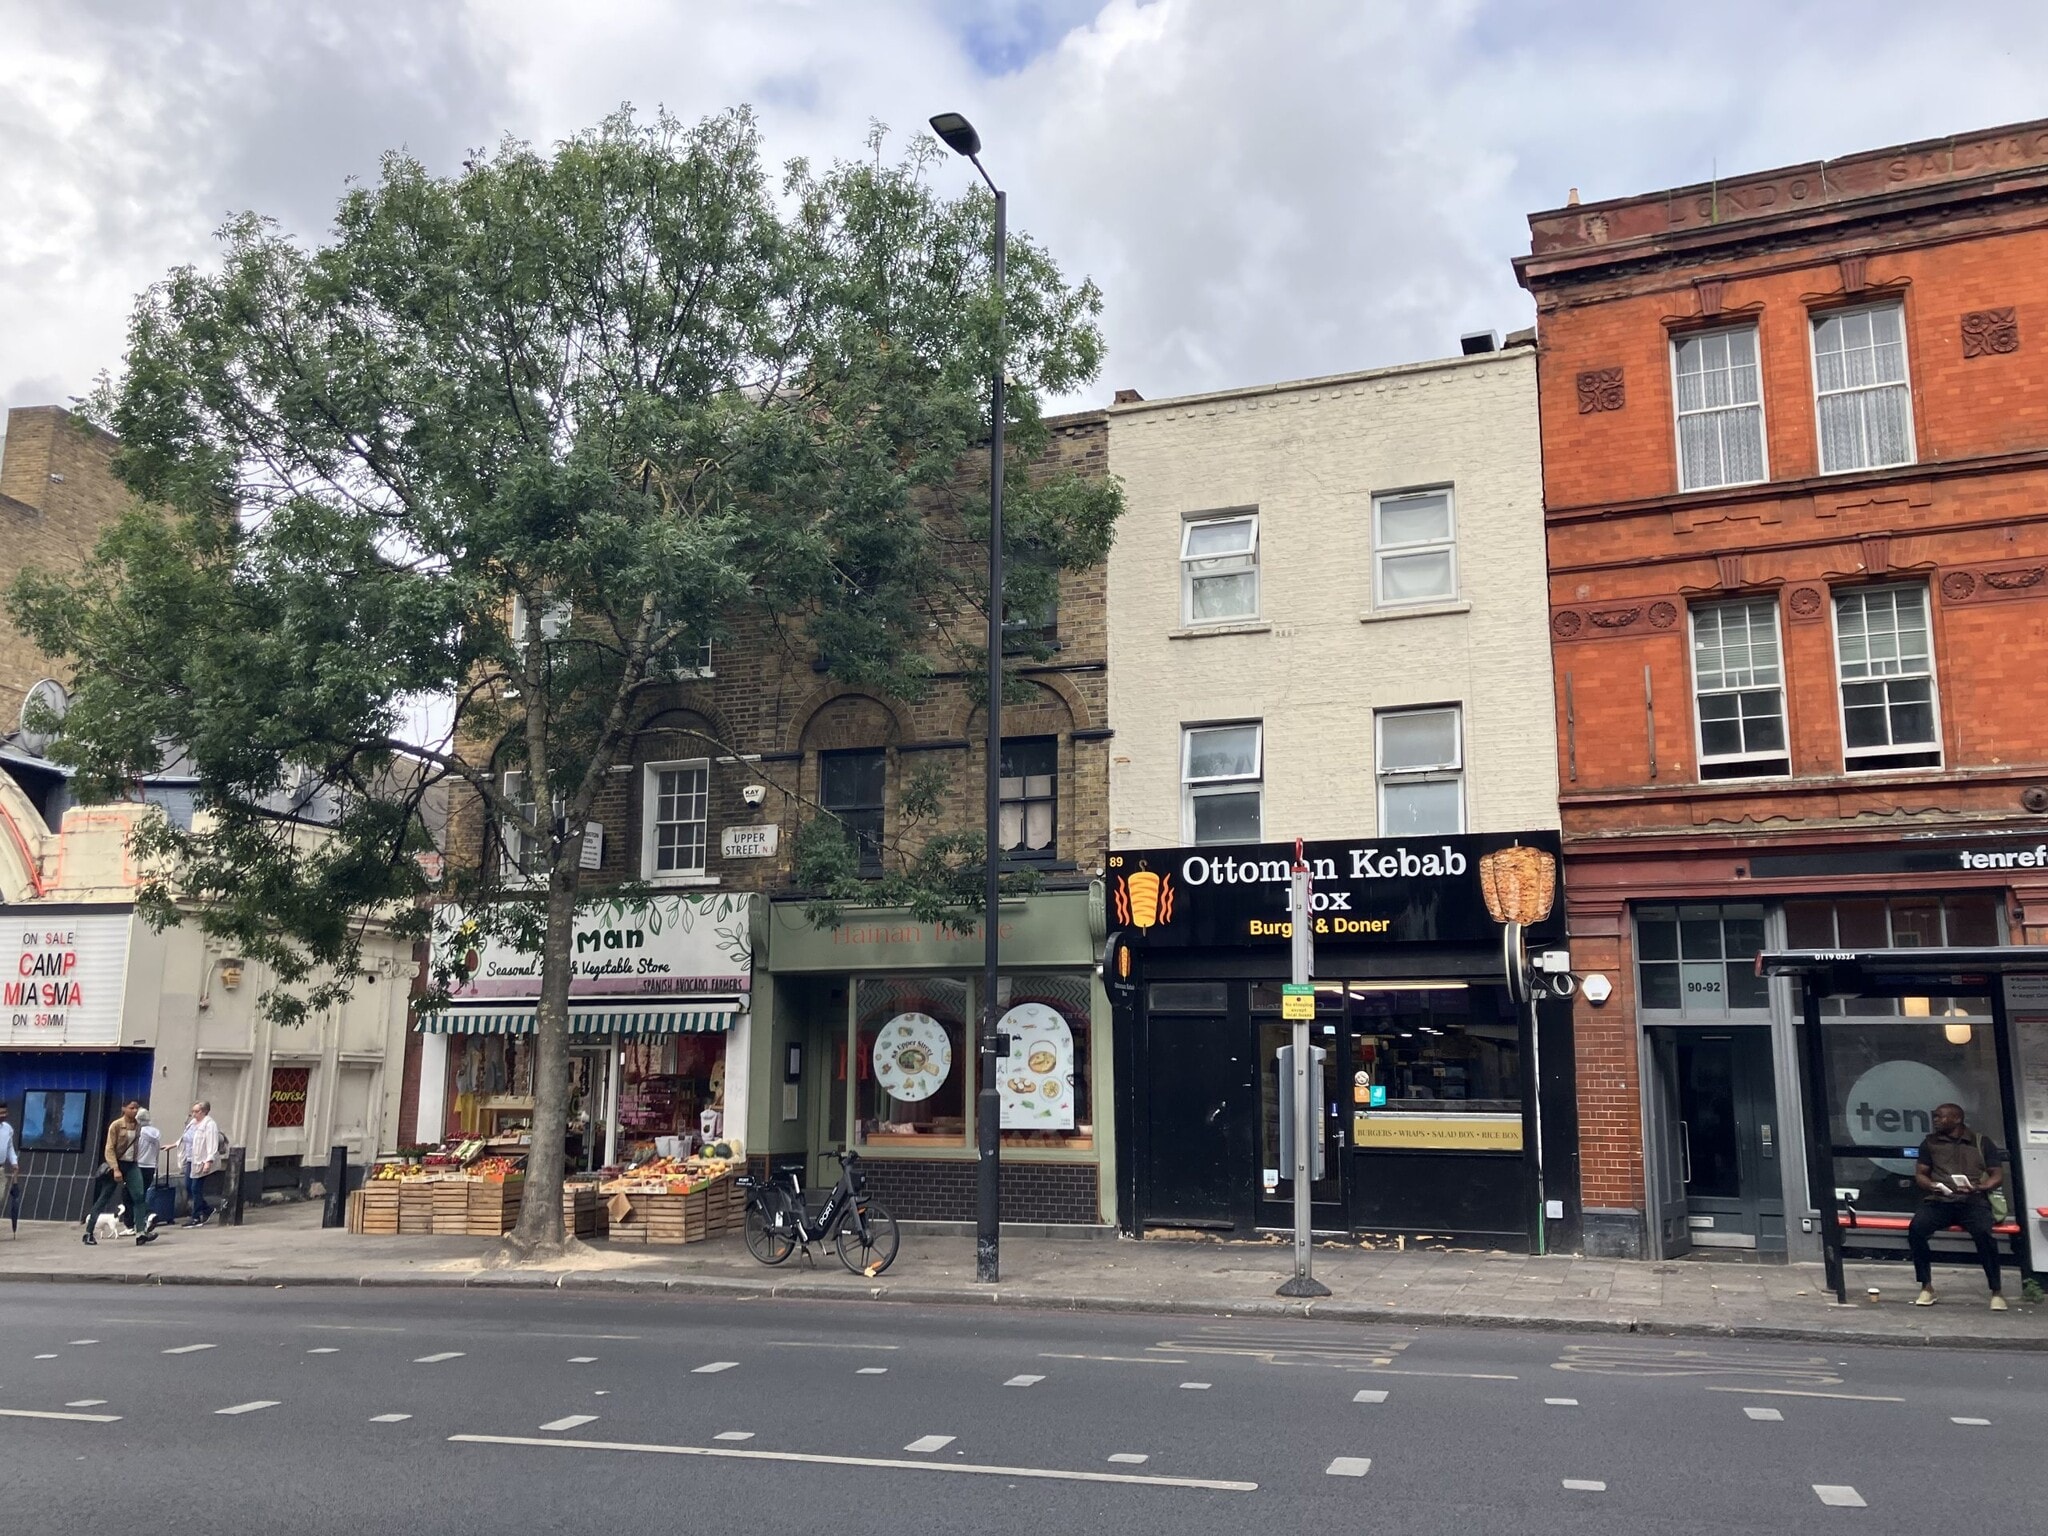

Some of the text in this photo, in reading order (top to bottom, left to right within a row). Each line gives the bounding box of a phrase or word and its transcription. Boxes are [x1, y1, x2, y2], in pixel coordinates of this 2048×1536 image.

[1665, 172, 1846, 225] LONDON
[734, 832, 766, 844] UPPER
[1109, 856, 1124, 867] 89
[1349, 846, 1467, 879] Kebab
[1960, 844, 2048, 869] tenref
[833, 924, 921, 945] Hainan
[1250, 918, 1390, 938] Burg & Doner
[22, 932, 74, 945] ON SALE
[19, 952, 76, 977] CAMP
[486, 958, 536, 977] Seasonal
[582, 956, 633, 981] Vegetable
[636, 957, 671, 975] Store
[643, 978, 743, 993] SPANISH AVOCADO FARMERS
[1687, 982, 1721, 992] 90-92
[12, 1013, 64, 1026] ON 35MM
[1856, 1102, 1937, 1133] ten
[1357, 1129, 1393, 1137] BURGERS
[1399, 1130, 1426, 1138] WRAPS
[1431, 1130, 1457, 1138] SALAD
[1458, 1131, 1475, 1139] BOX
[1481, 1131, 1501, 1139] RICE
